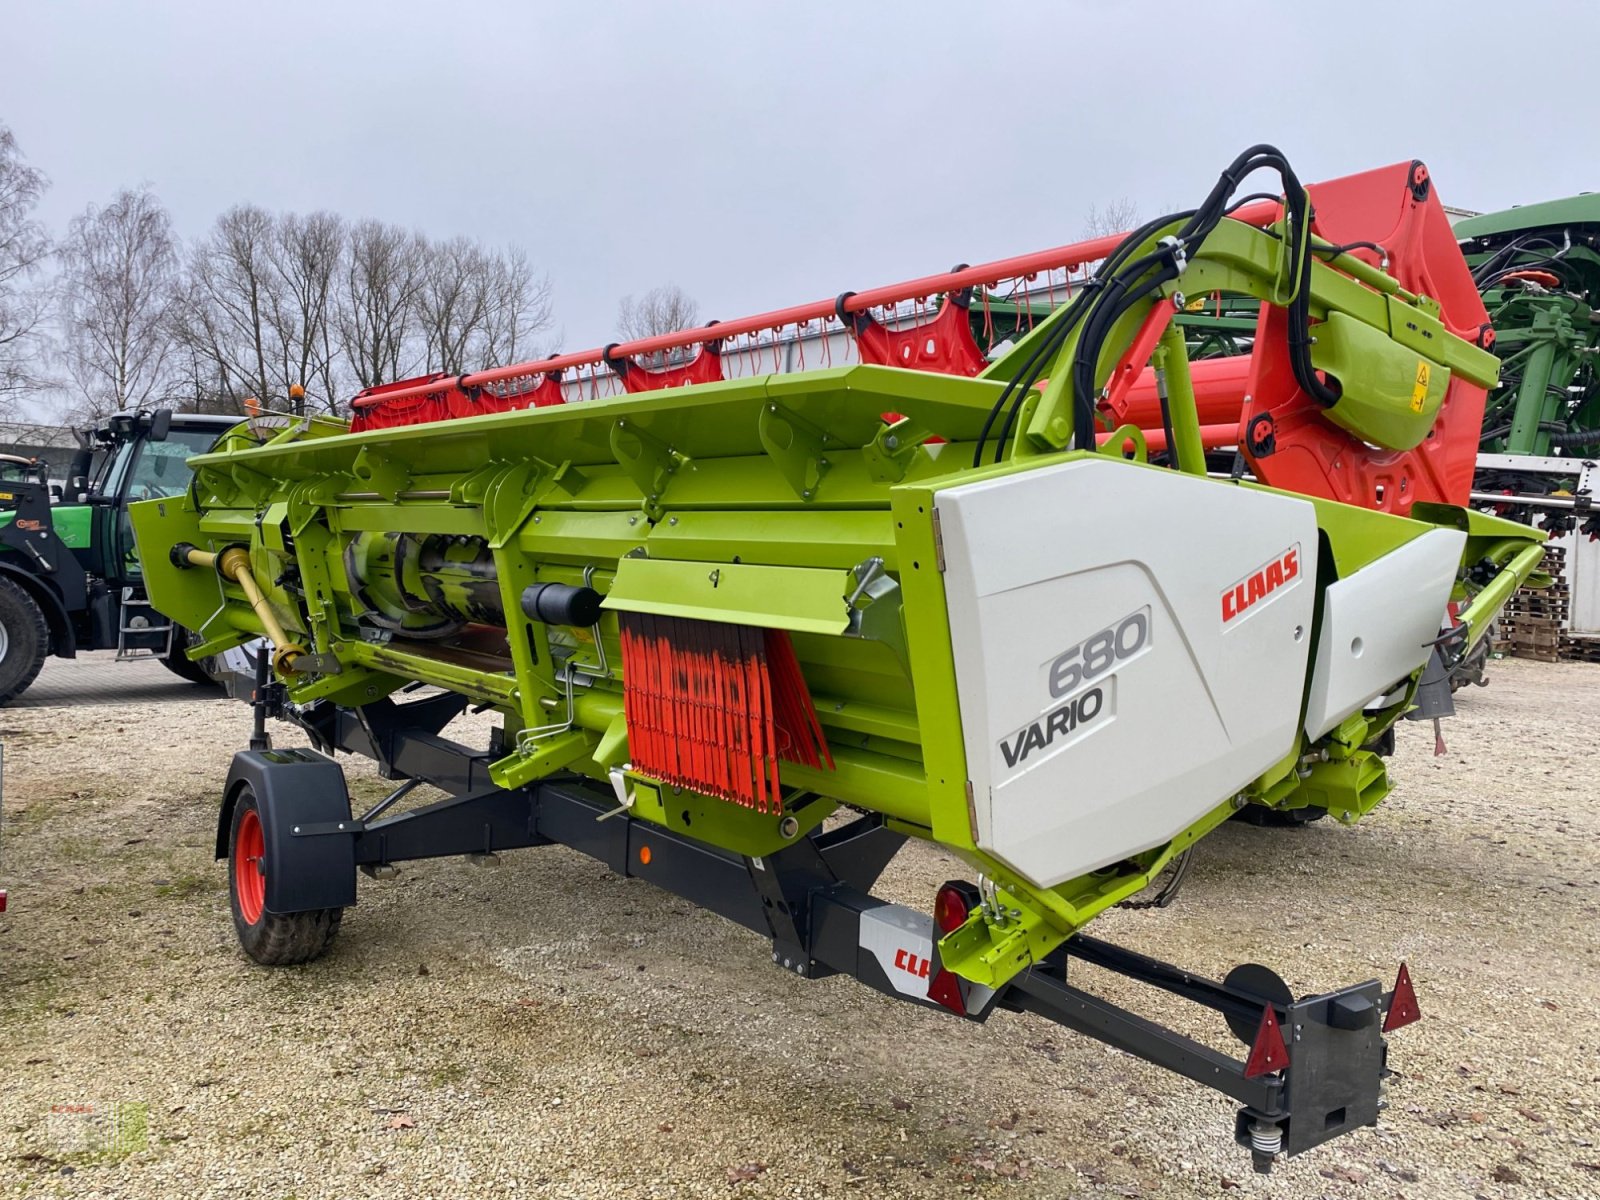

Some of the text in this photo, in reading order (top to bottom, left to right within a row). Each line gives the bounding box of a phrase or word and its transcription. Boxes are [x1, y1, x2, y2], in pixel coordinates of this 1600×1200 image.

[1221, 549, 1298, 623] CLAAS
[1049, 613, 1147, 699] 680
[1000, 687, 1103, 768] VARIO
[894, 948, 931, 979] CLA
